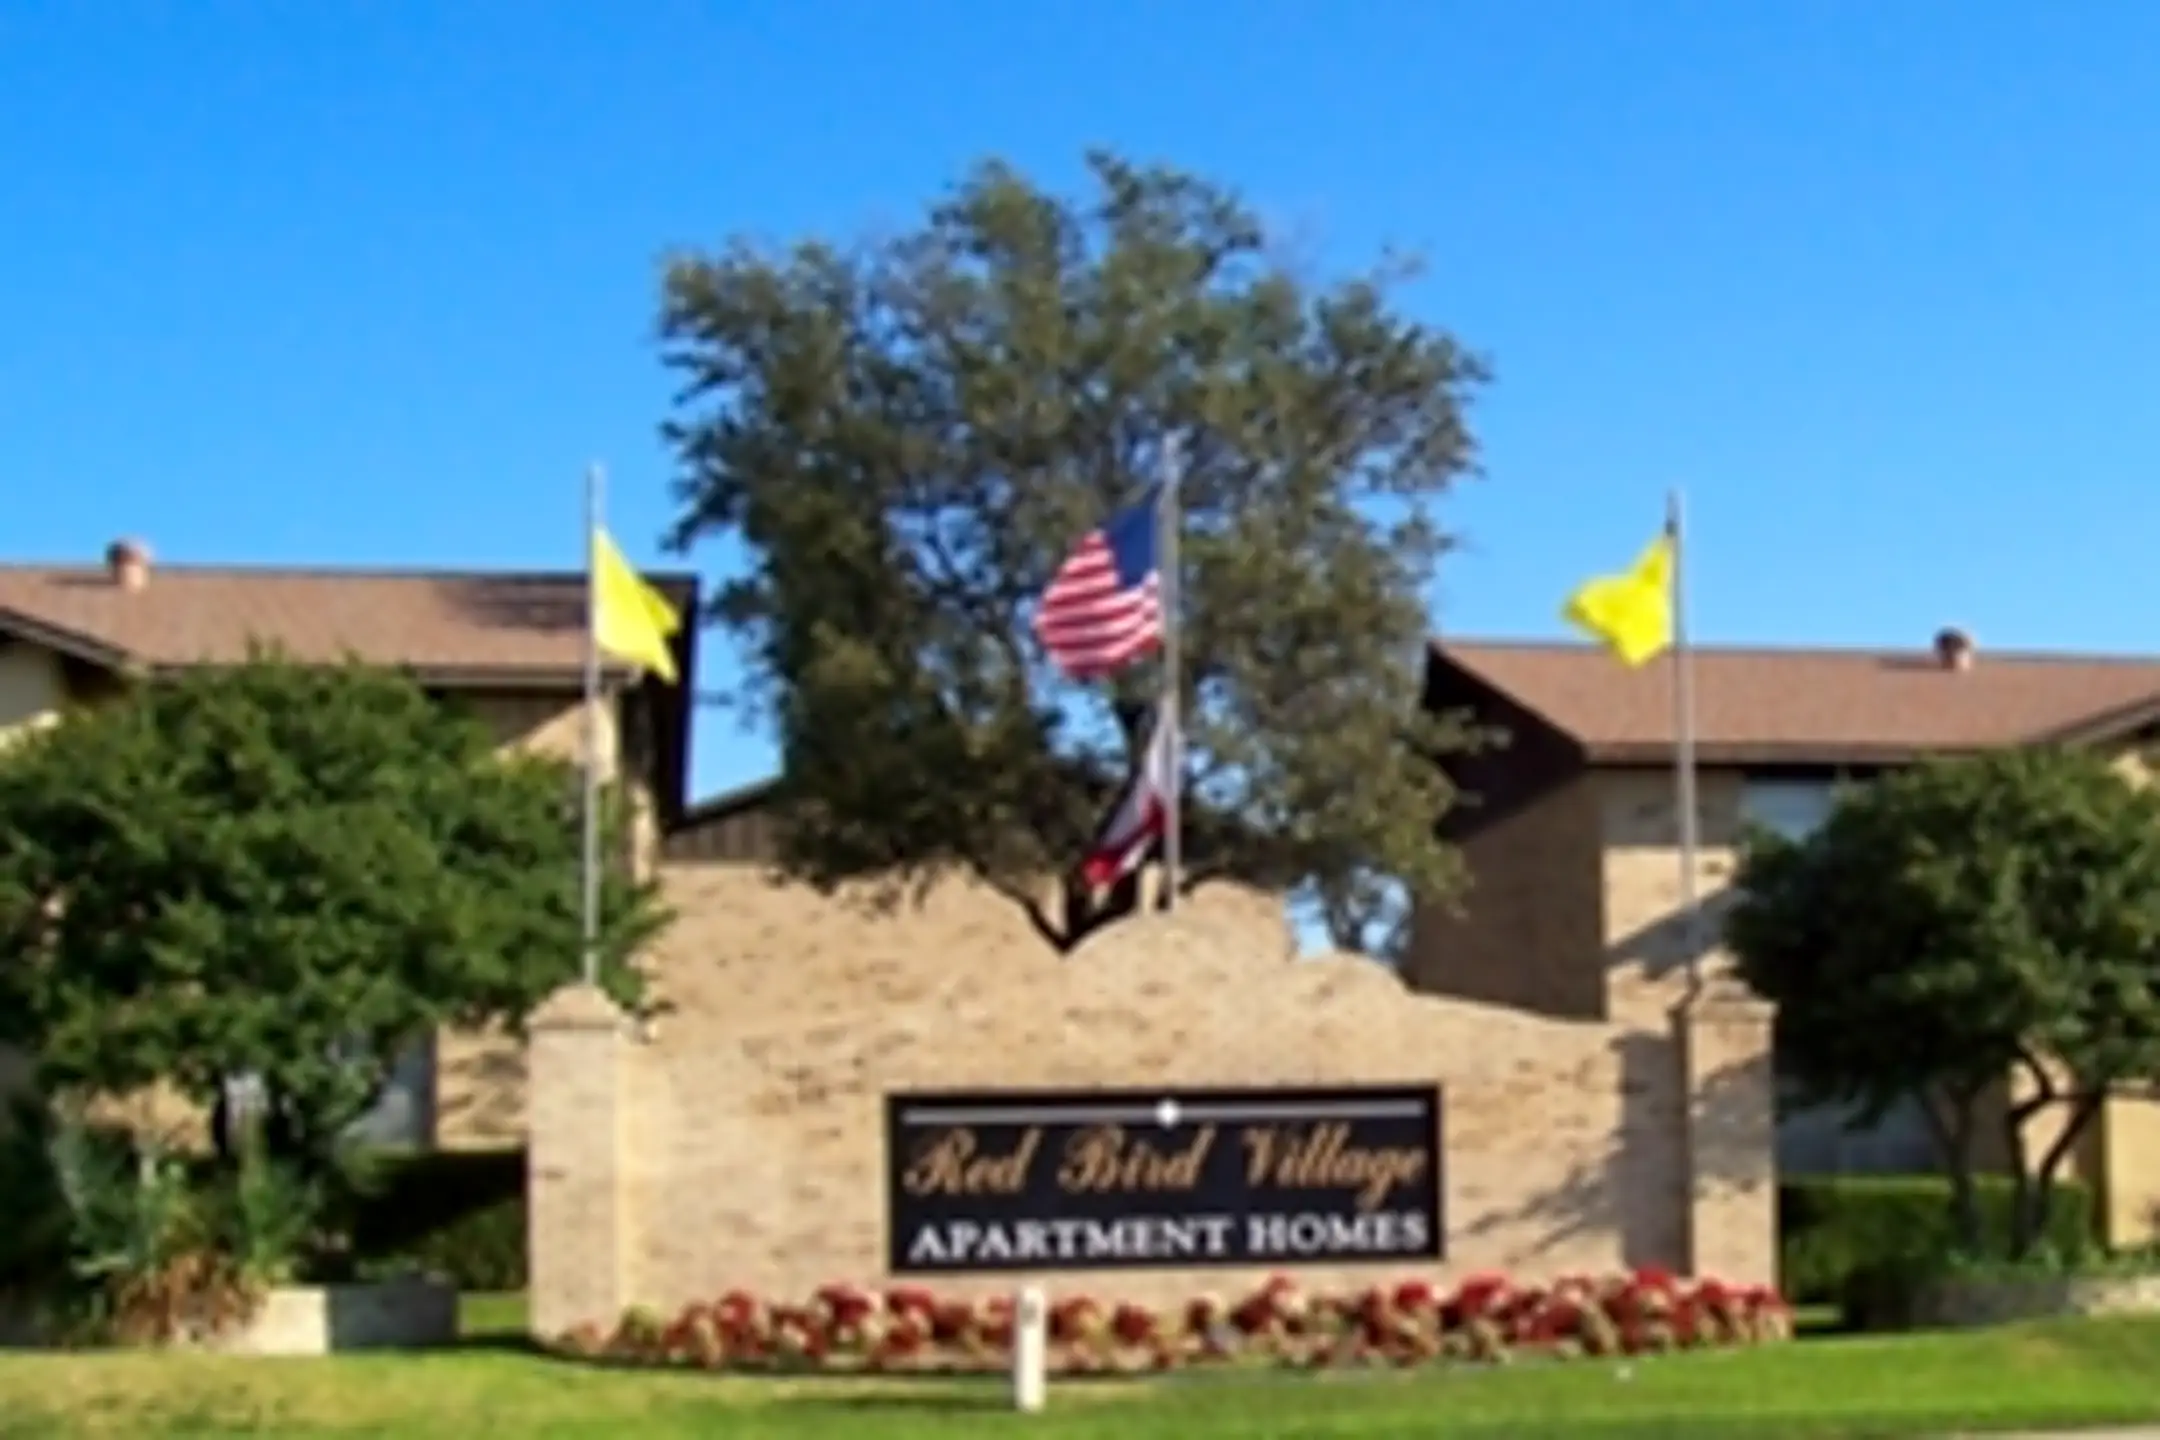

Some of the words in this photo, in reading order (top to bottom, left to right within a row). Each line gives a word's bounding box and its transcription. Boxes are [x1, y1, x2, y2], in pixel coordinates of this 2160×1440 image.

[903, 1125, 1042, 1196] Red
[1057, 1123, 1216, 1191] Bird
[1243, 1121, 1427, 1211] Village
[907, 1215, 1237, 1262] APARTMENT
[1247, 1207, 1430, 1253] HOMES
